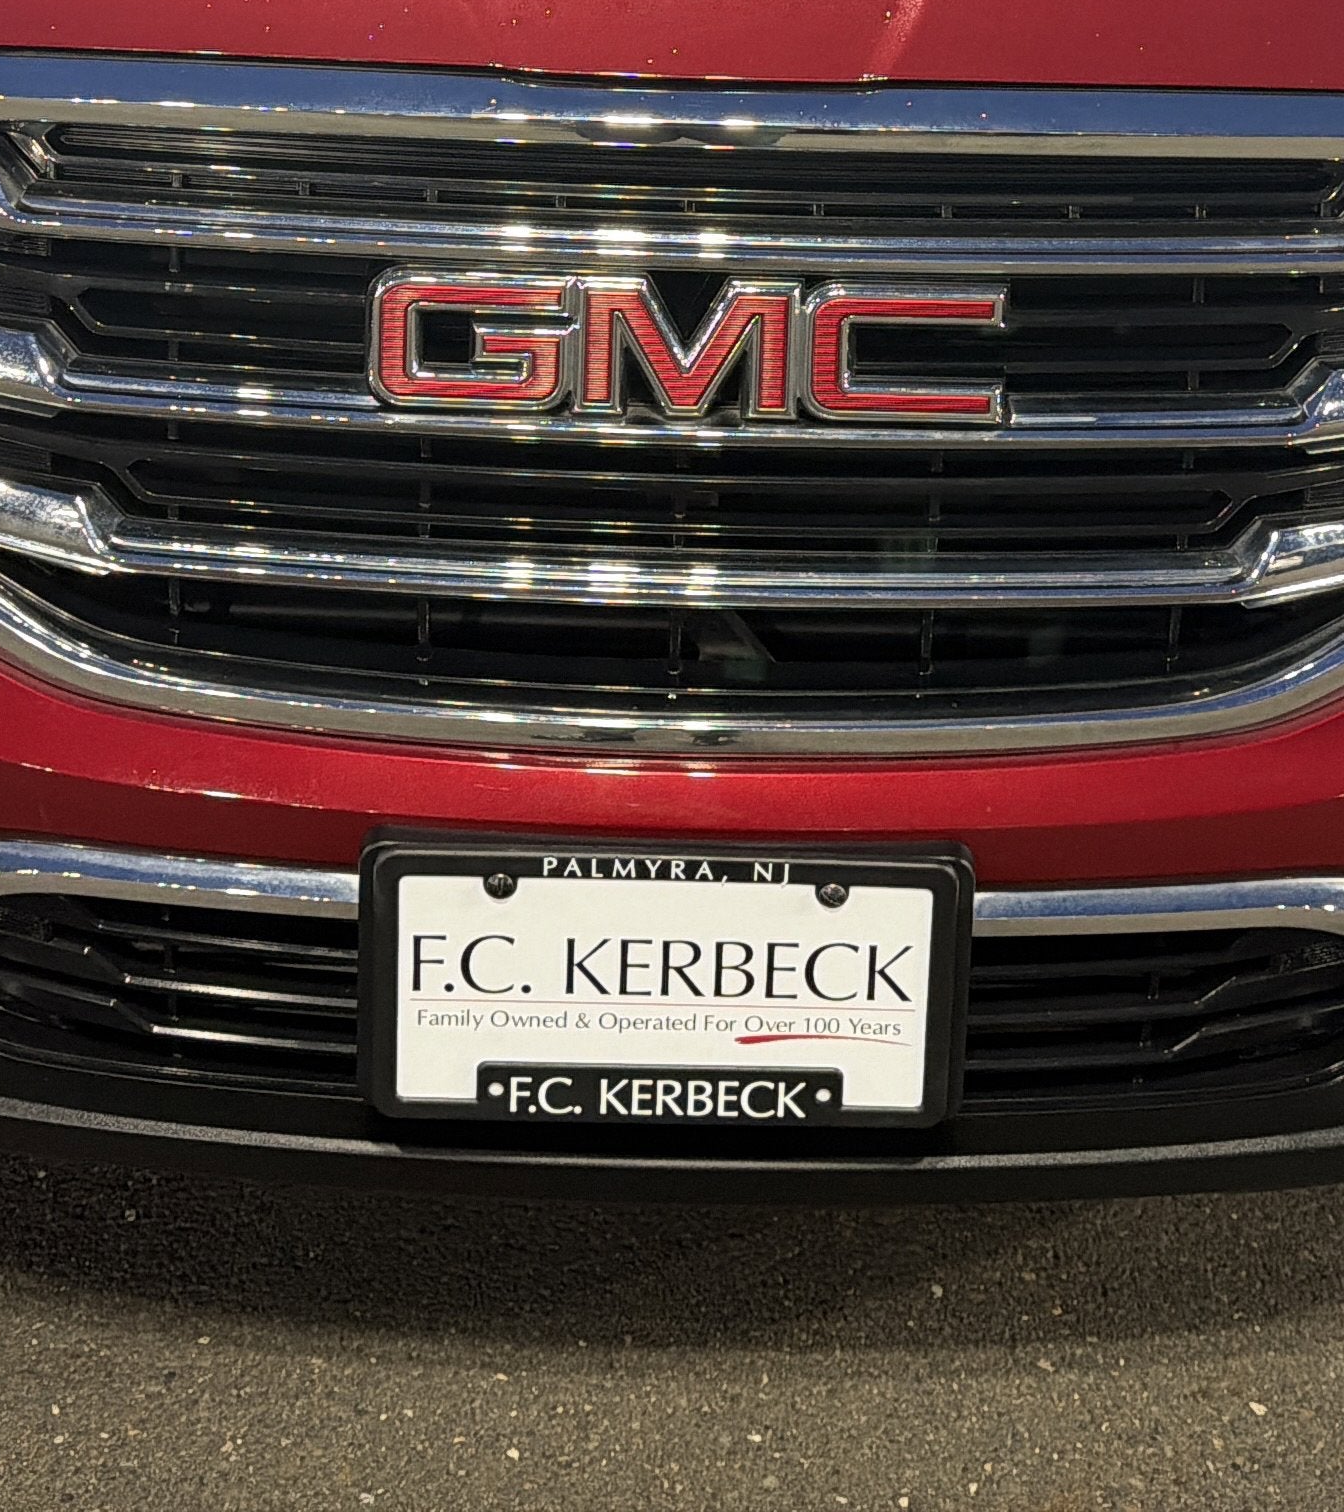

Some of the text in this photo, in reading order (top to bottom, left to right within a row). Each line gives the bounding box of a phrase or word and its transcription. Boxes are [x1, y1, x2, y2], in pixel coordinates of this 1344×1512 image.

[368, 265, 1008, 421] GMC
[542, 856, 791, 889] PALMYRA, NJ
[412, 934, 914, 1003] F.C. KERBECK
[417, 1009, 901, 1036] Family Owned & Operated For Over 100 Years
[509, 1076, 807, 1119] F.C. KERBECK
